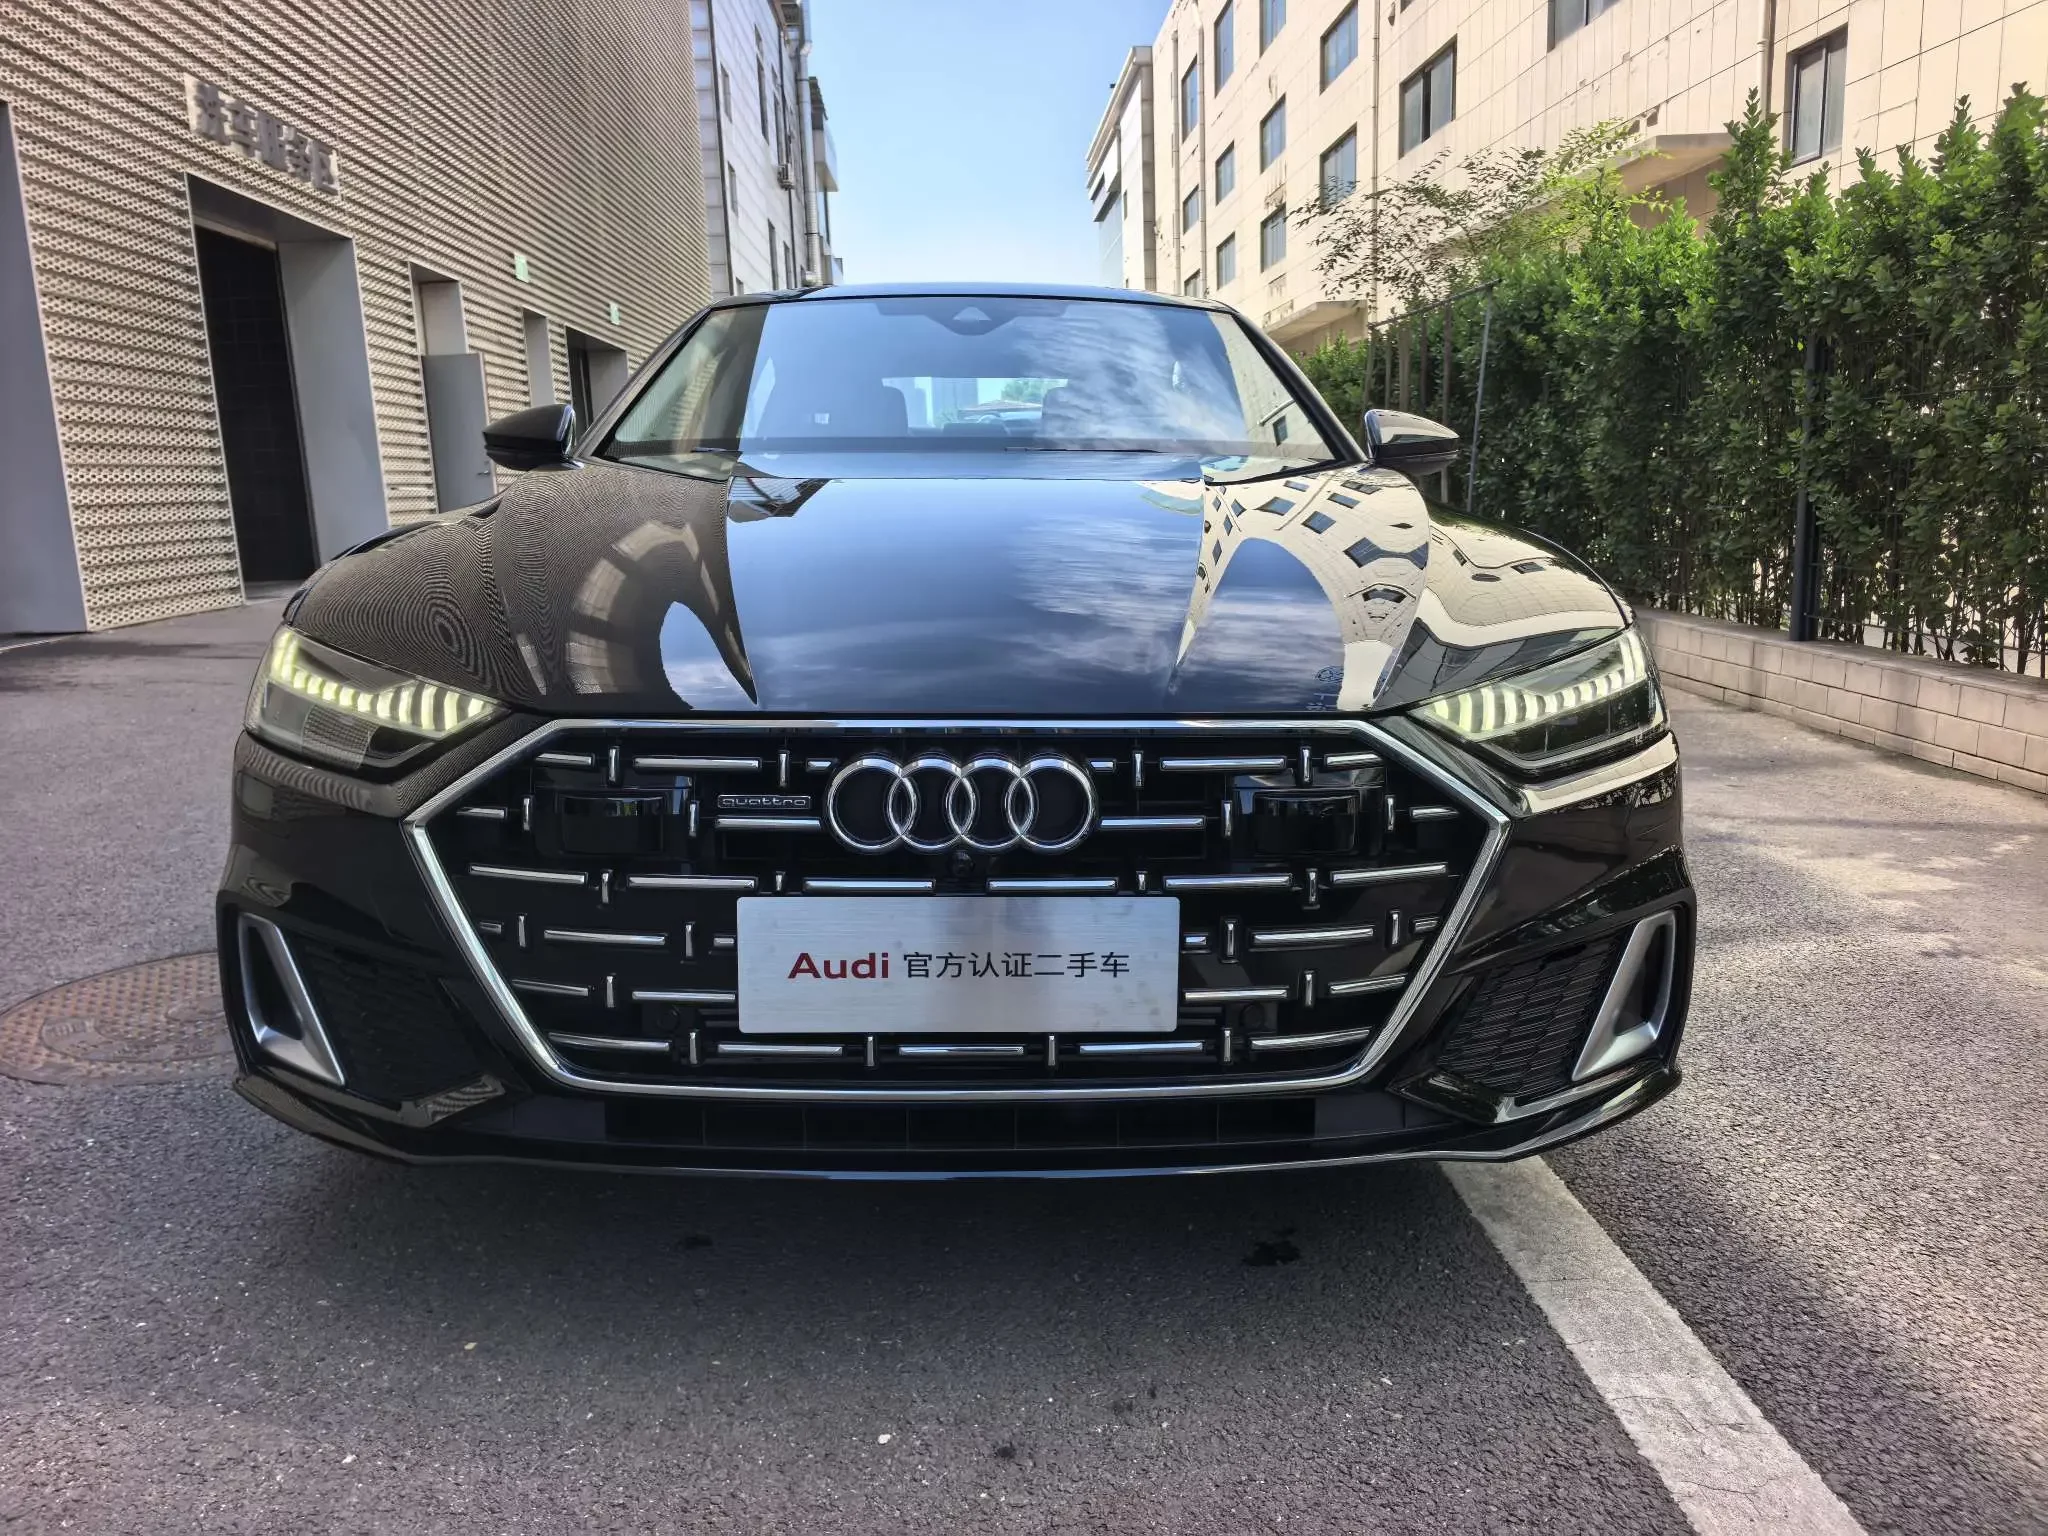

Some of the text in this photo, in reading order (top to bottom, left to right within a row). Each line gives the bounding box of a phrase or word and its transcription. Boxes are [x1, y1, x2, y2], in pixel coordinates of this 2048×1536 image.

[722, 797, 806, 807] quattro
[788, 951, 1130, 979] Audi 官方认证二手车
